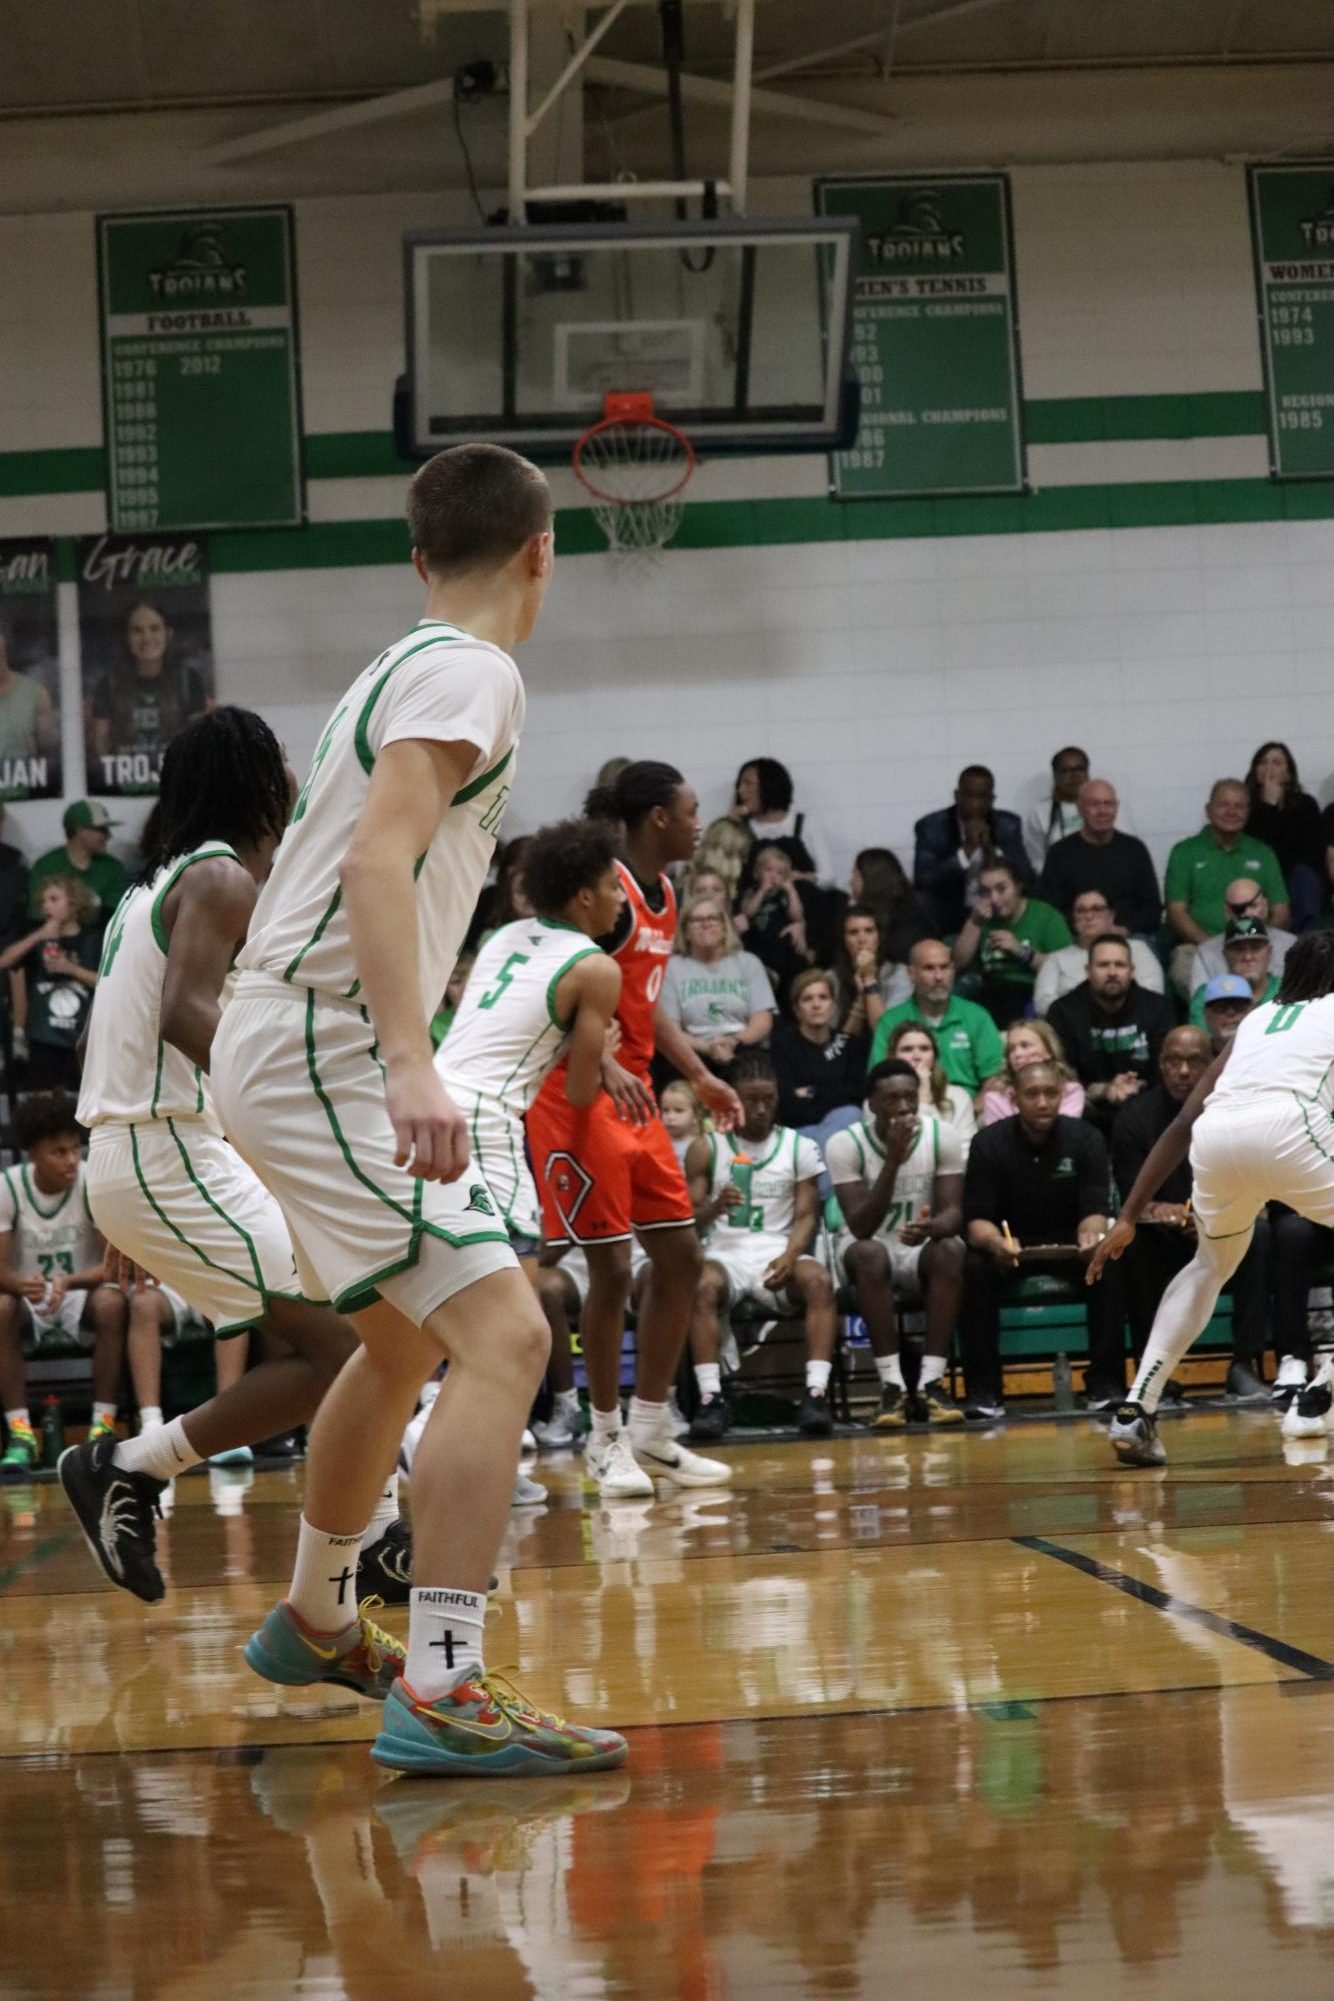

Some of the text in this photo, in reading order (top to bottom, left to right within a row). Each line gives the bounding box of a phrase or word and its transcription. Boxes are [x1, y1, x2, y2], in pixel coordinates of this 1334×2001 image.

[915, 276, 987, 295] TENNIS
[148, 310, 252, 332] FOOTBALL
[1271, 306, 1312, 325] 1974
[1273, 327, 1314, 346] 1993
[180, 355, 222, 375] 2012
[921, 407, 1007, 424] CHAMPIONS
[1279, 410, 1323, 430] 1985
[83, 537, 197, 591] Grace
[478, 952, 531, 1010] 5
[647, 964, 662, 1002] 0
